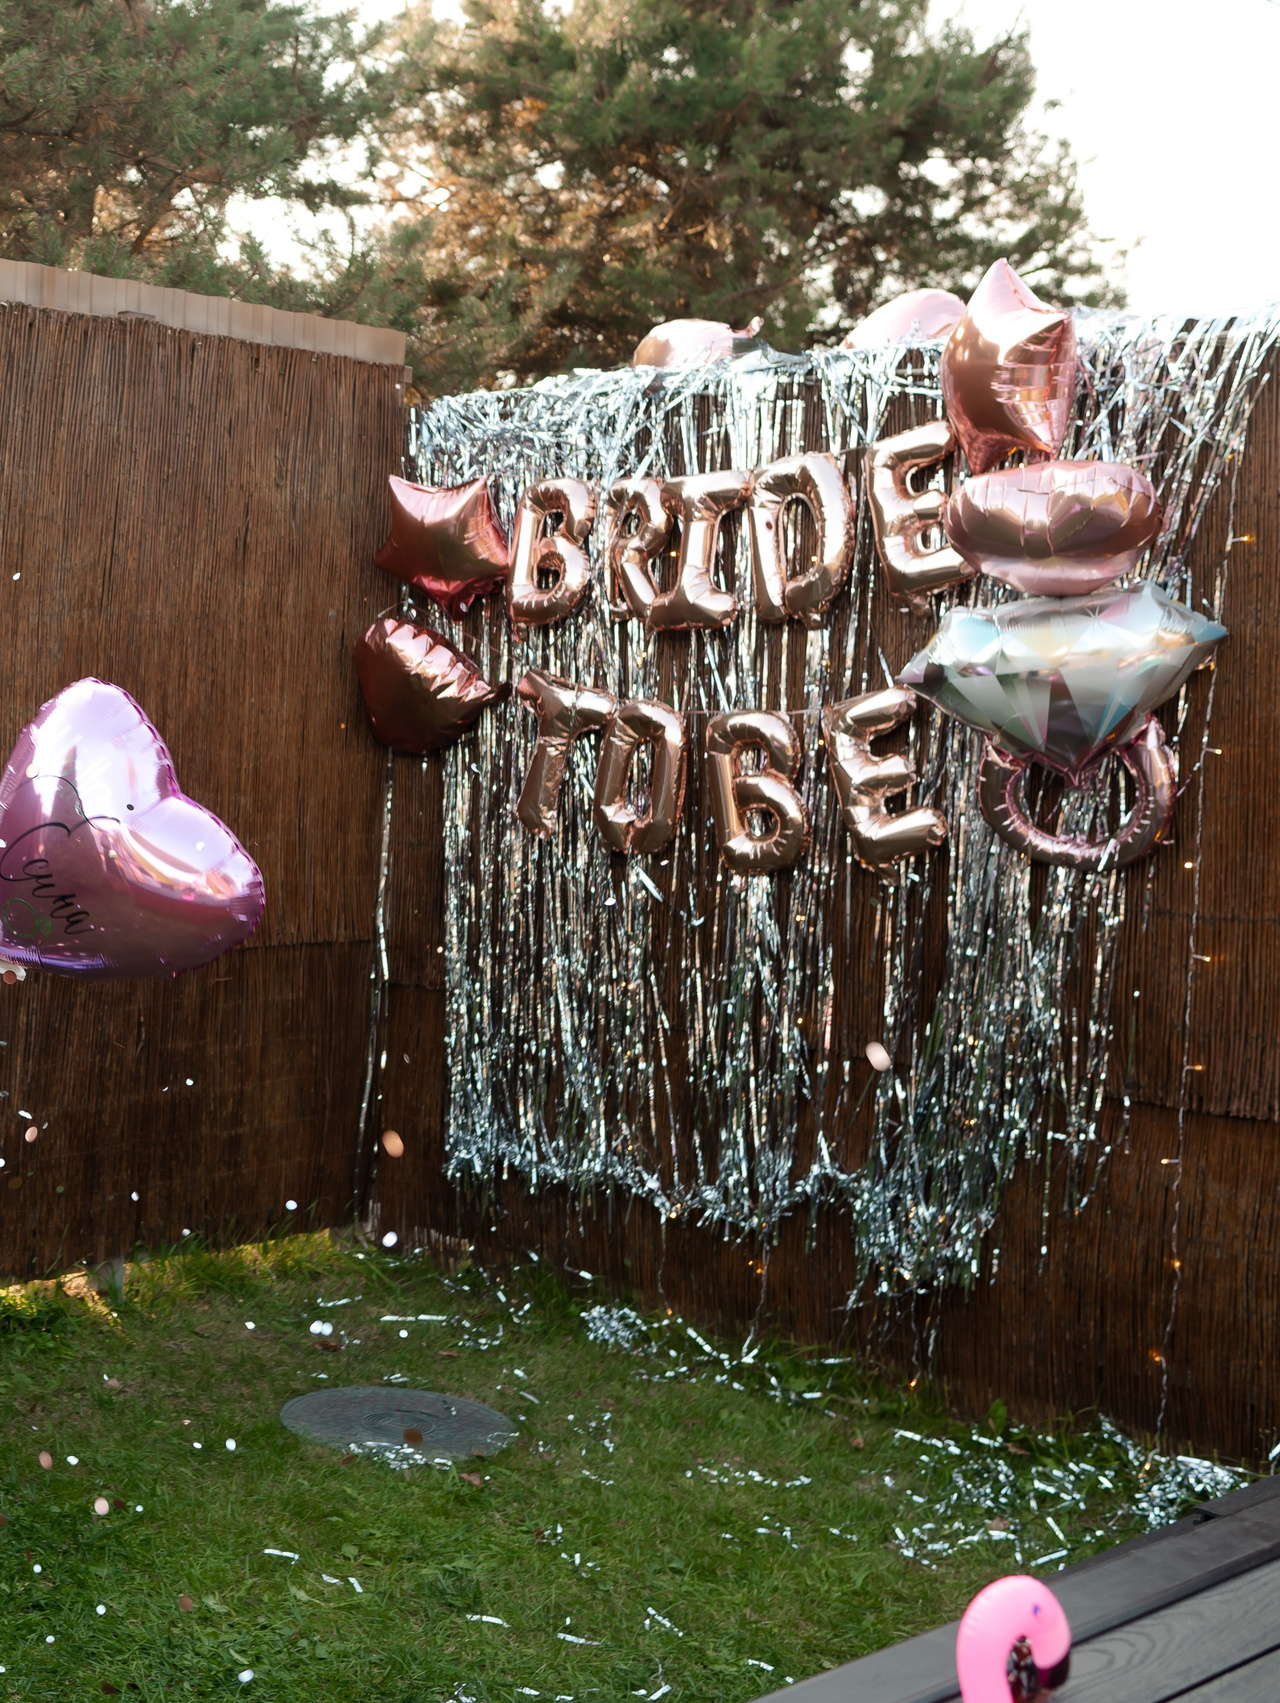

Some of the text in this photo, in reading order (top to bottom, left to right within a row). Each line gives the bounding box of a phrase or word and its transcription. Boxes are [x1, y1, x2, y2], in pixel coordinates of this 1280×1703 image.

[508, 421, 978, 632] BRIDE
[518, 670, 948, 880] TO BE
